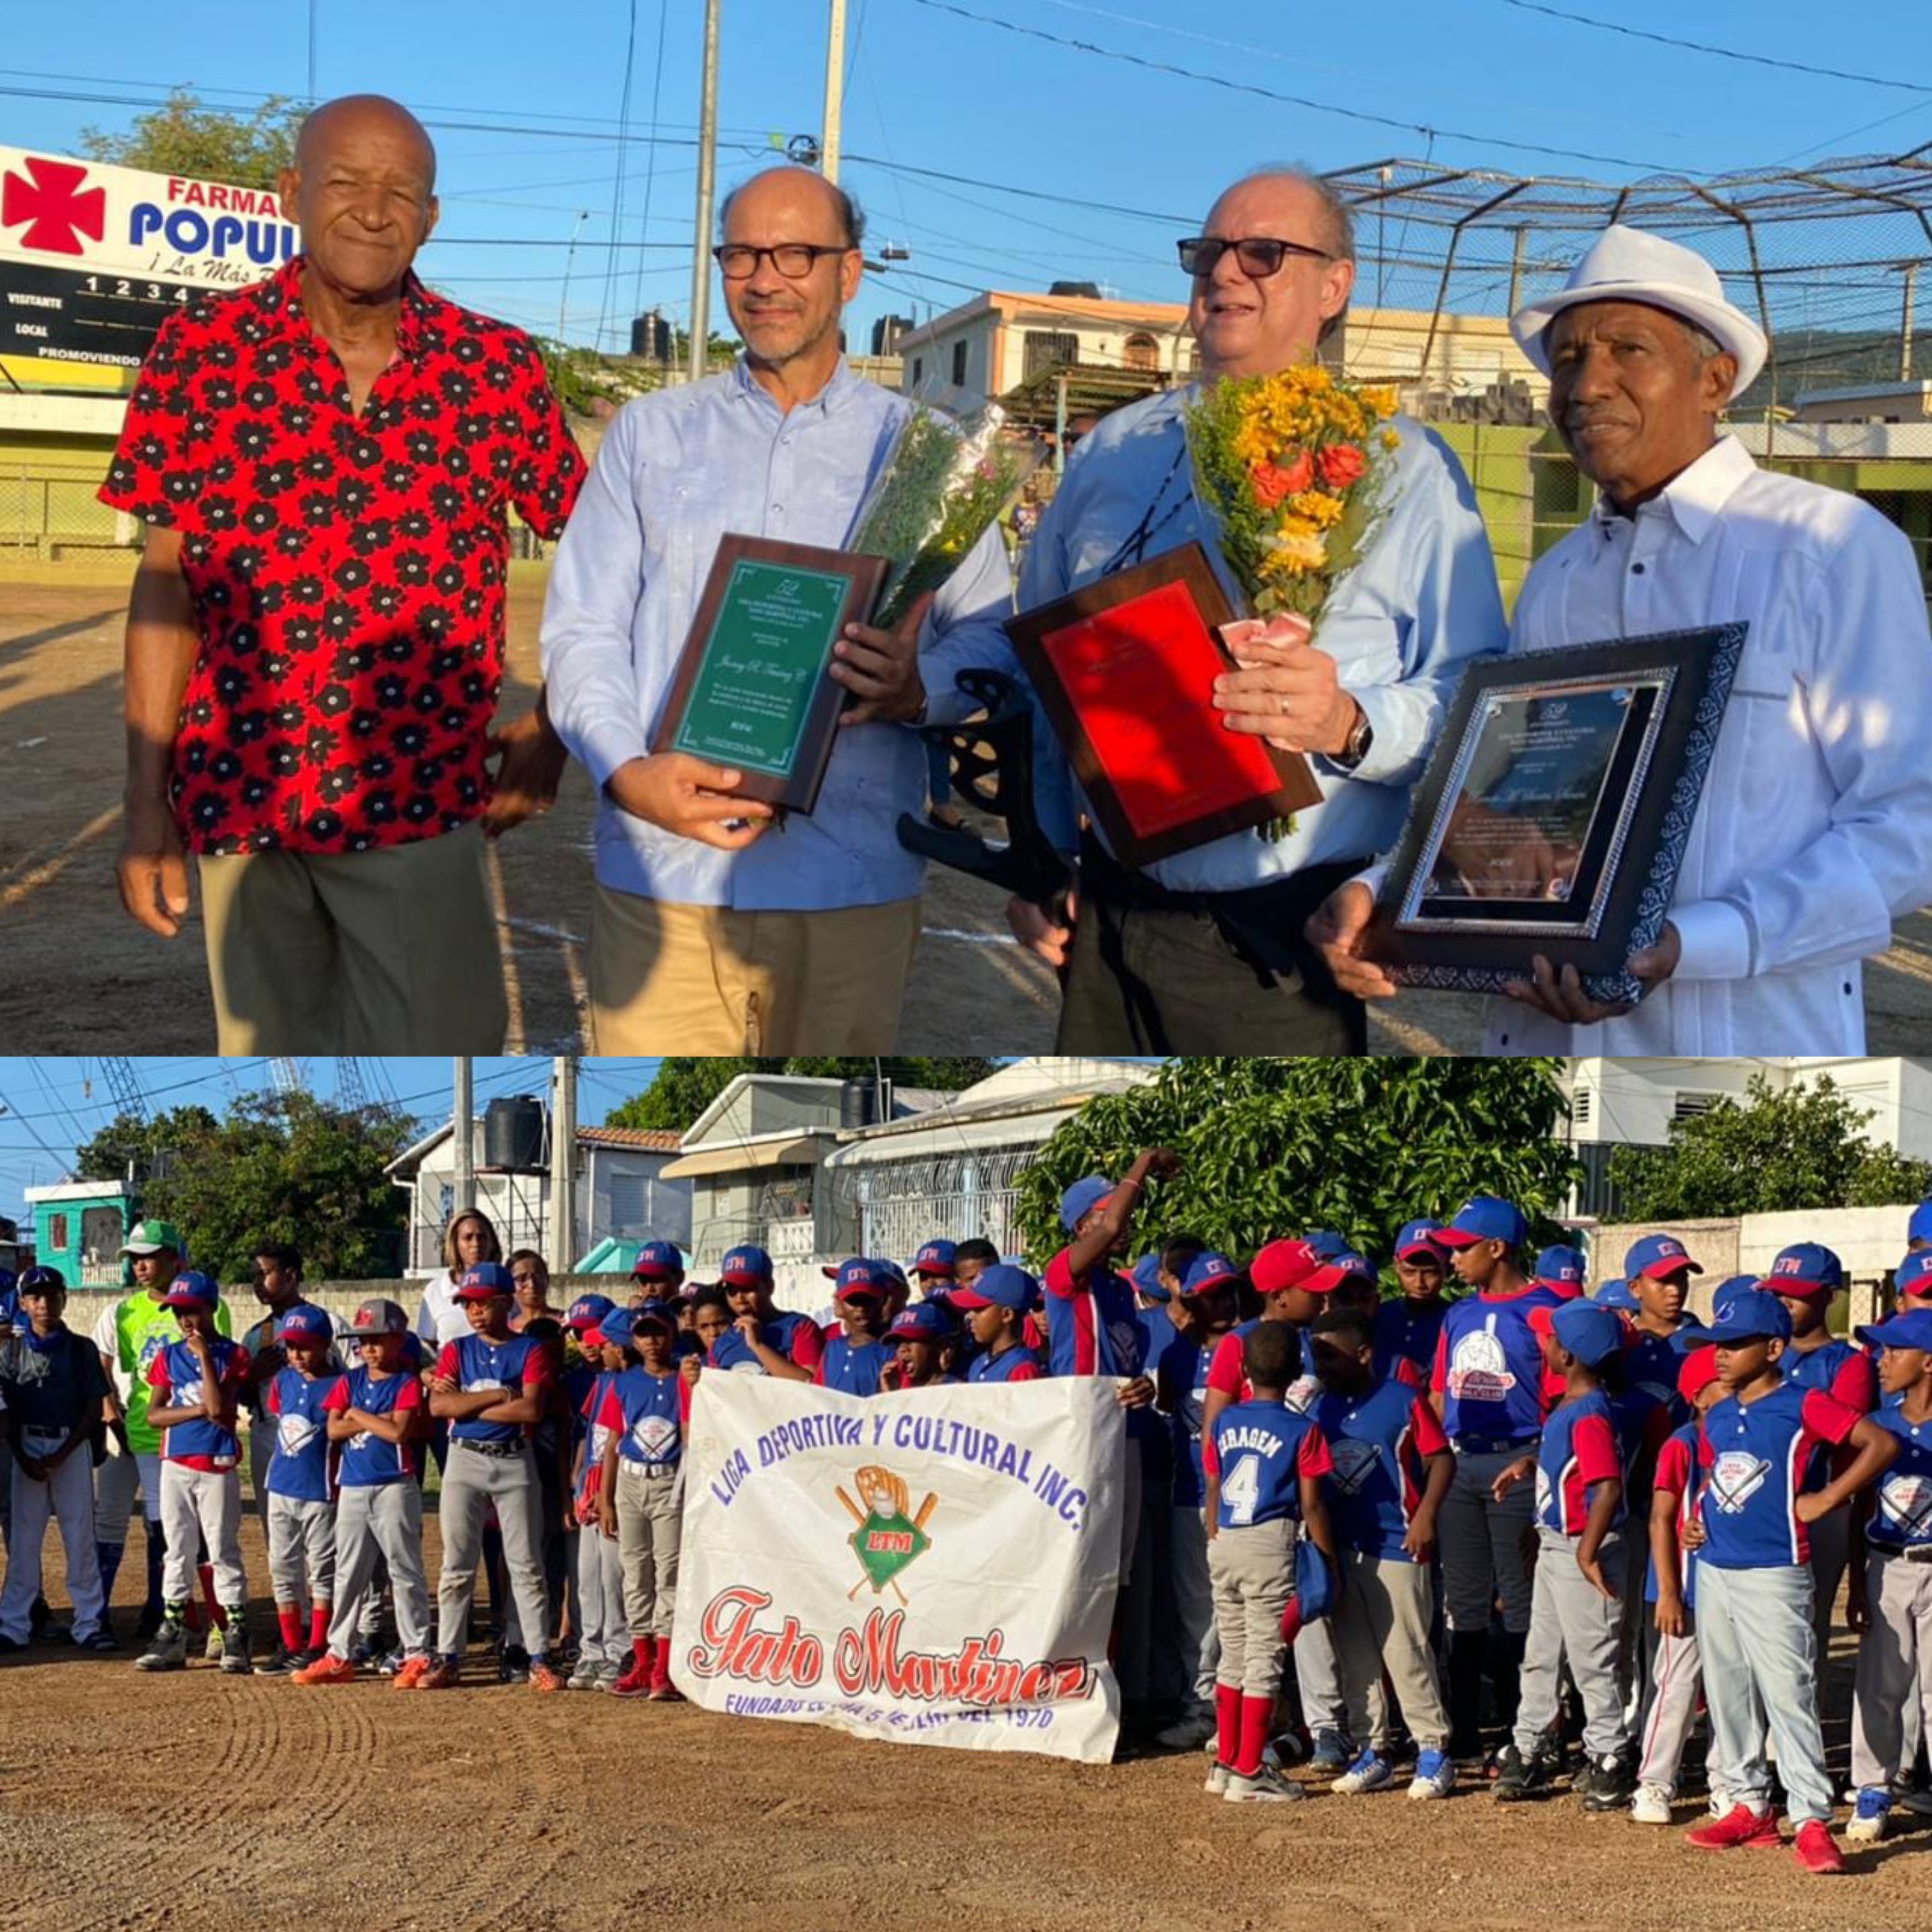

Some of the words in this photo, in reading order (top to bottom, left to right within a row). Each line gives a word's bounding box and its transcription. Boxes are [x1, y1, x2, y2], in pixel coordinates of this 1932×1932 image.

[168, 178, 278, 218] FARMA
[7, 292, 62, 310] VISITANTE
[87, 276, 97, 291] 1
[117, 280, 130, 295] 2
[148, 284, 160, 299] 3
[174, 287, 189, 302] 4
[15, 323, 48, 338] LOCAL
[38, 346, 141, 366] PROMOVIENDO
[711, 1448, 751, 1507] LIGA
[757, 1413, 865, 1468] DEPORTIVA
[873, 1413, 889, 1446] Y
[894, 1413, 1032, 1485] CULTURAL
[1033, 1463, 1088, 1531] INC.
[1221, 1454, 1259, 1524] 4
[866, 1530, 914, 1554] LTM
[687, 1585, 824, 1688] Tato
[834, 1607, 1098, 1706] Martinez
[725, 1693, 806, 1715] FUNDADO
[1005, 1707, 1053, 1729] 1970
